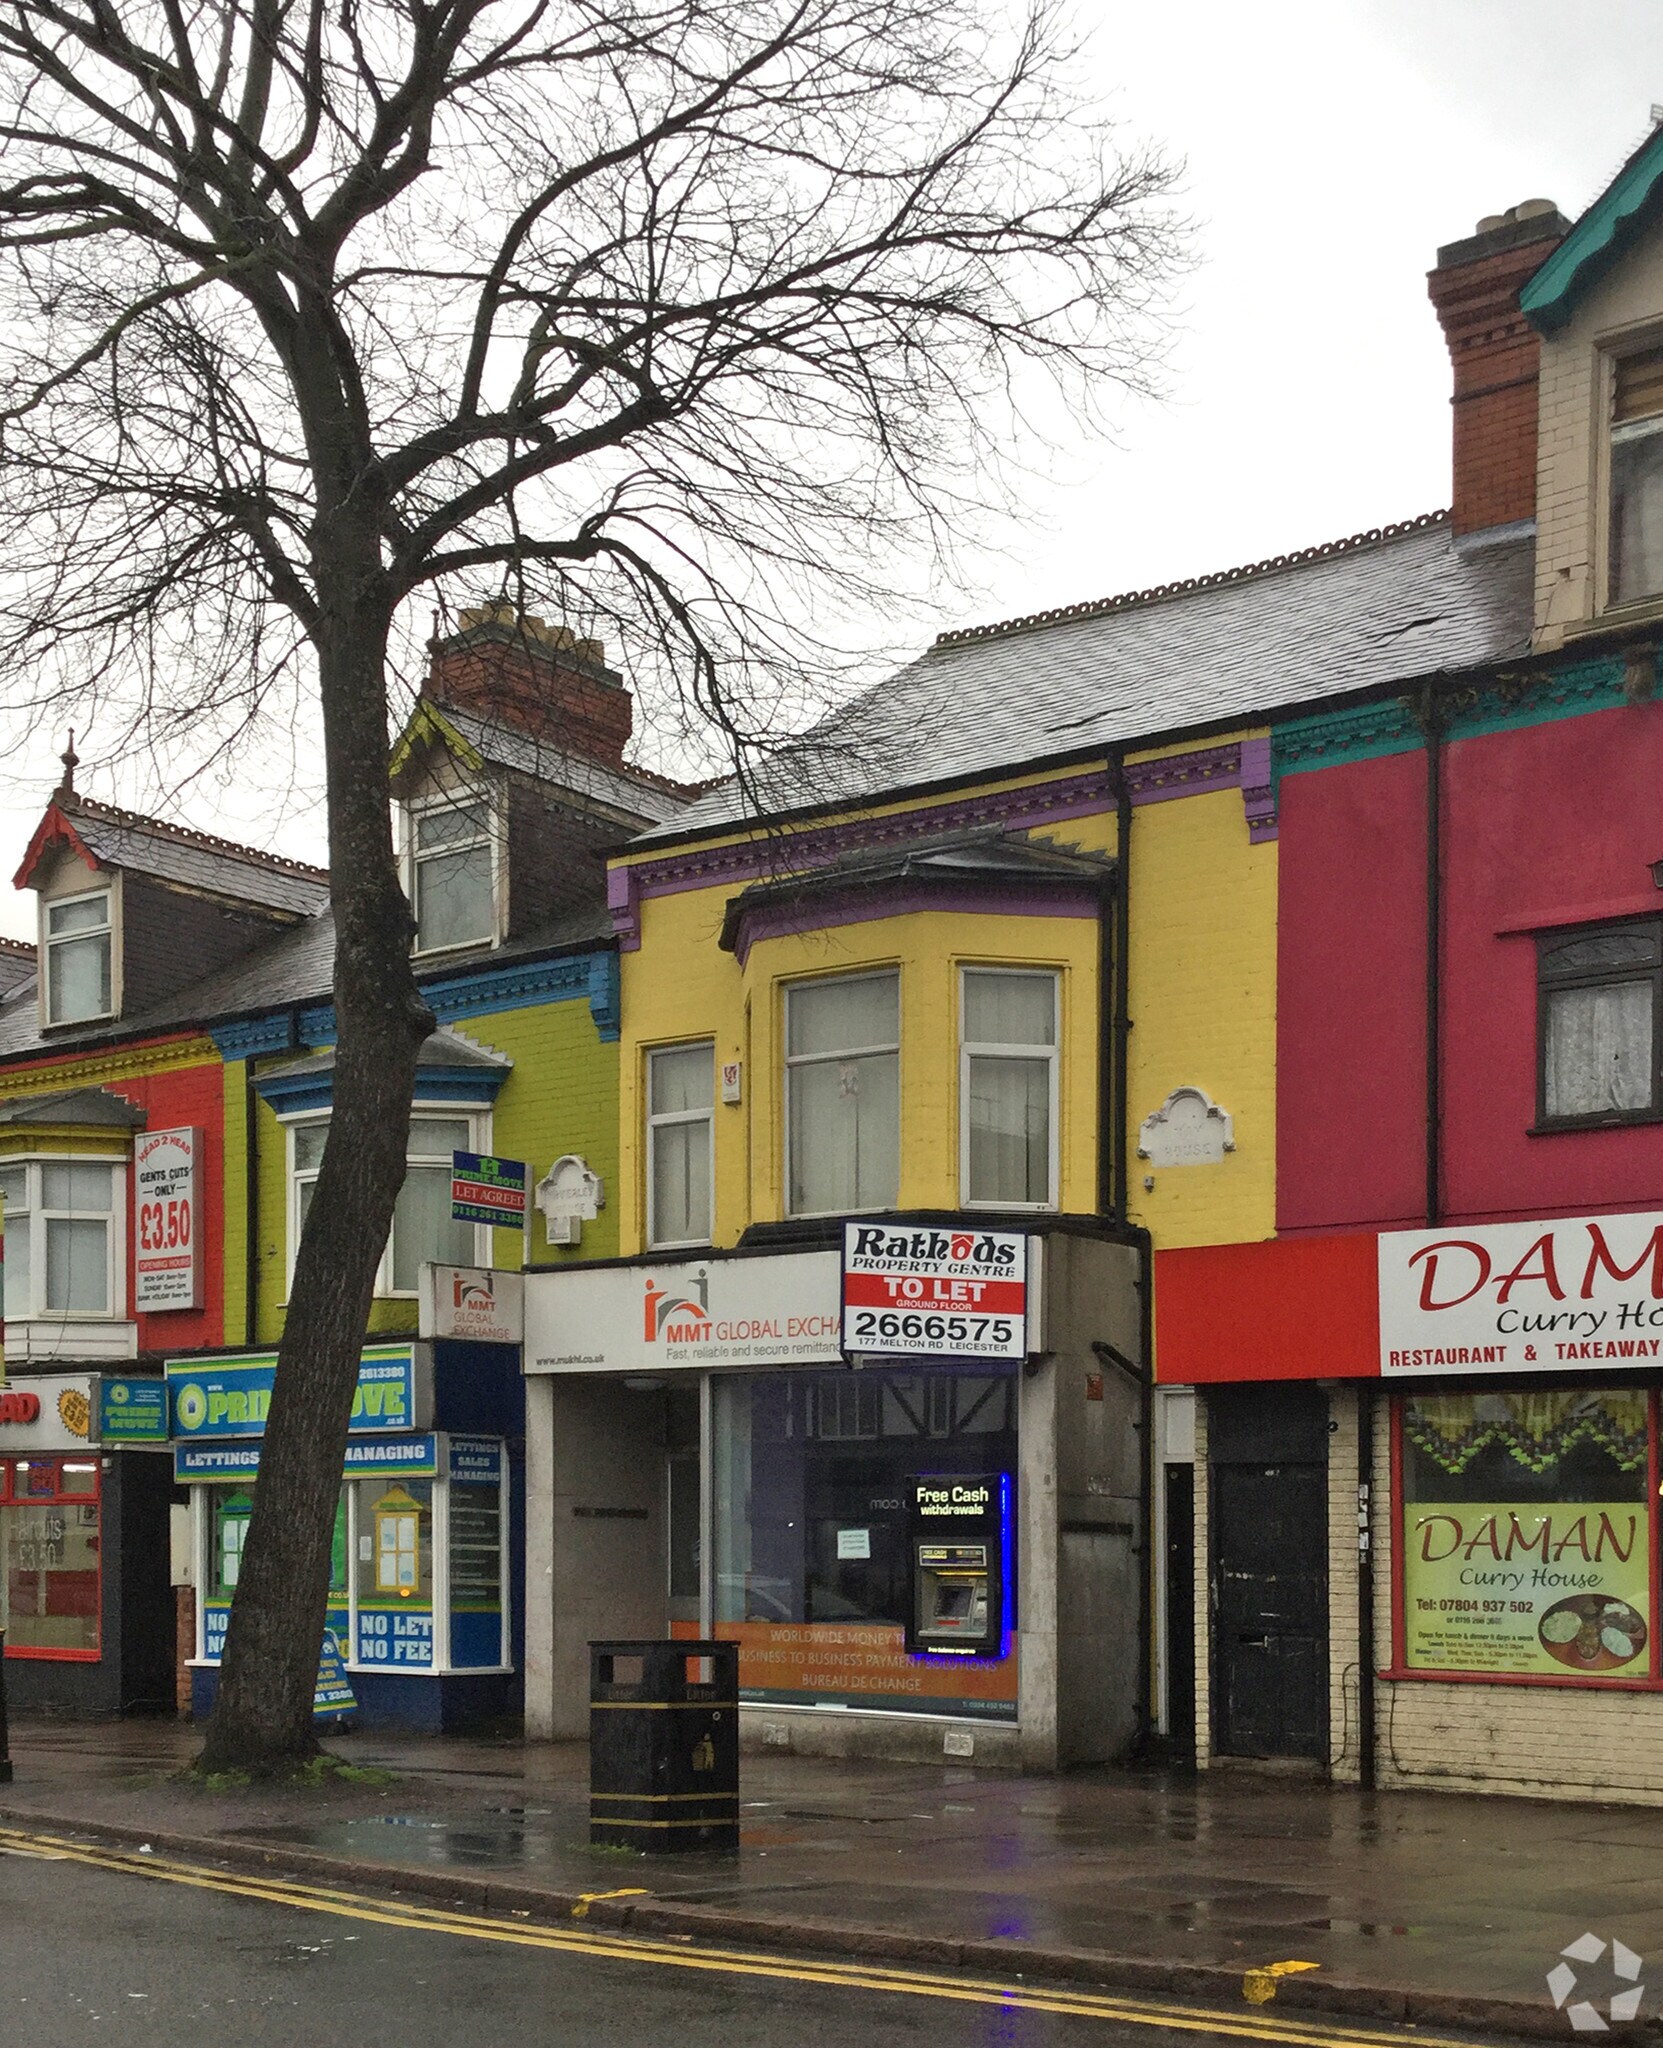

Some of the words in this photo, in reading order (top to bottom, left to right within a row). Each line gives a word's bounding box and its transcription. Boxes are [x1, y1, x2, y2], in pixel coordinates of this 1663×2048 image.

[139, 1138, 160, 1162] HEAD
[162, 1135, 169, 1146] 2
[170, 1136, 192, 1156] HEAD
[140, 1169, 166, 1183] GENTS
[169, 1167, 189, 1180] CUTS
[454, 1168, 489, 1181] PRIME
[492, 1175, 523, 1188] MOVE
[154, 1184, 176, 1197] ONLY
[455, 1185, 479, 1199] LET
[480, 1190, 525, 1206] AGREED
[453, 1205, 478, 1217] 0116
[140, 1199, 191, 1250] £3.50
[853, 1228, 1016, 1264] Rathods
[140, 1259, 167, 1271] OPENING
[168, 1257, 191, 1268] HOURS
[852, 1258, 942, 1273] PROPERTY
[1408, 1223, 1663, 1311] DAM
[883, 1276, 924, 1299] TO
[933, 1279, 987, 1302] LET
[468, 1300, 496, 1312] MMT
[896, 1299, 938, 1309] GROUND
[940, 1301, 973, 1311] FLOOR
[453, 1311, 495, 1325] GLOBAL
[1497, 1308, 1607, 1338] Curry
[453, 1324, 511, 1339] EXCHANGE
[667, 1322, 712, 1343] MMT
[716, 1321, 782, 1341] GLOBAL
[855, 1312, 1012, 1343] 2666575
[667, 1347, 689, 1362] Fast,
[692, 1344, 729, 1359] reliable
[732, 1344, 751, 1357] and
[754, 1344, 789, 1356] secure
[859, 1337, 877, 1346] 177
[880, 1339, 925, 1348] MELTON
[928, 1341, 944, 1349] RD
[949, 1342, 1008, 1352] LEICESTER
[1389, 1345, 1507, 1367] RESTAURANT
[1524, 1344, 1537, 1361] &
[1554, 1339, 1660, 1360] TAKEAWAY
[0, 1392, 41, 1423] AD
[185, 1450, 260, 1467] LETTINGS
[458, 1457, 490, 1467] SALES
[916, 1487, 949, 1502] Free
[952, 1486, 989, 1503] Cash
[920, 1503, 984, 1516] withdrawals
[1415, 1511, 1636, 1564] DAMAN
[1460, 1568, 1524, 1591] Curry
[1530, 1567, 1604, 1589] House
[1416, 1598, 1437, 1611] Tel:
[1439, 1599, 1478, 1612] 07804
[1482, 1600, 1506, 1612] 937
[1510, 1601, 1533, 1613] 502
[207, 1613, 229, 1632] NO
[361, 1615, 388, 1635] NO
[393, 1616, 433, 1636] LET
[207, 1635, 226, 1653] N
[770, 1630, 847, 1644] WORLDWIDE
[850, 1632, 892, 1645] MONEY
[361, 1640, 388, 1659] NO
[394, 1640, 432, 1660] FEE
[789, 1651, 805, 1663] TO
[809, 1653, 863, 1667] BUSINESS
[865, 1655, 921, 1669] PAYMENT
[925, 1658, 998, 1671] SOLUTIONS
[802, 1673, 847, 1687] BUREAU
[851, 1676, 865, 1688] DE
[869, 1677, 921, 1690] CHANGE
